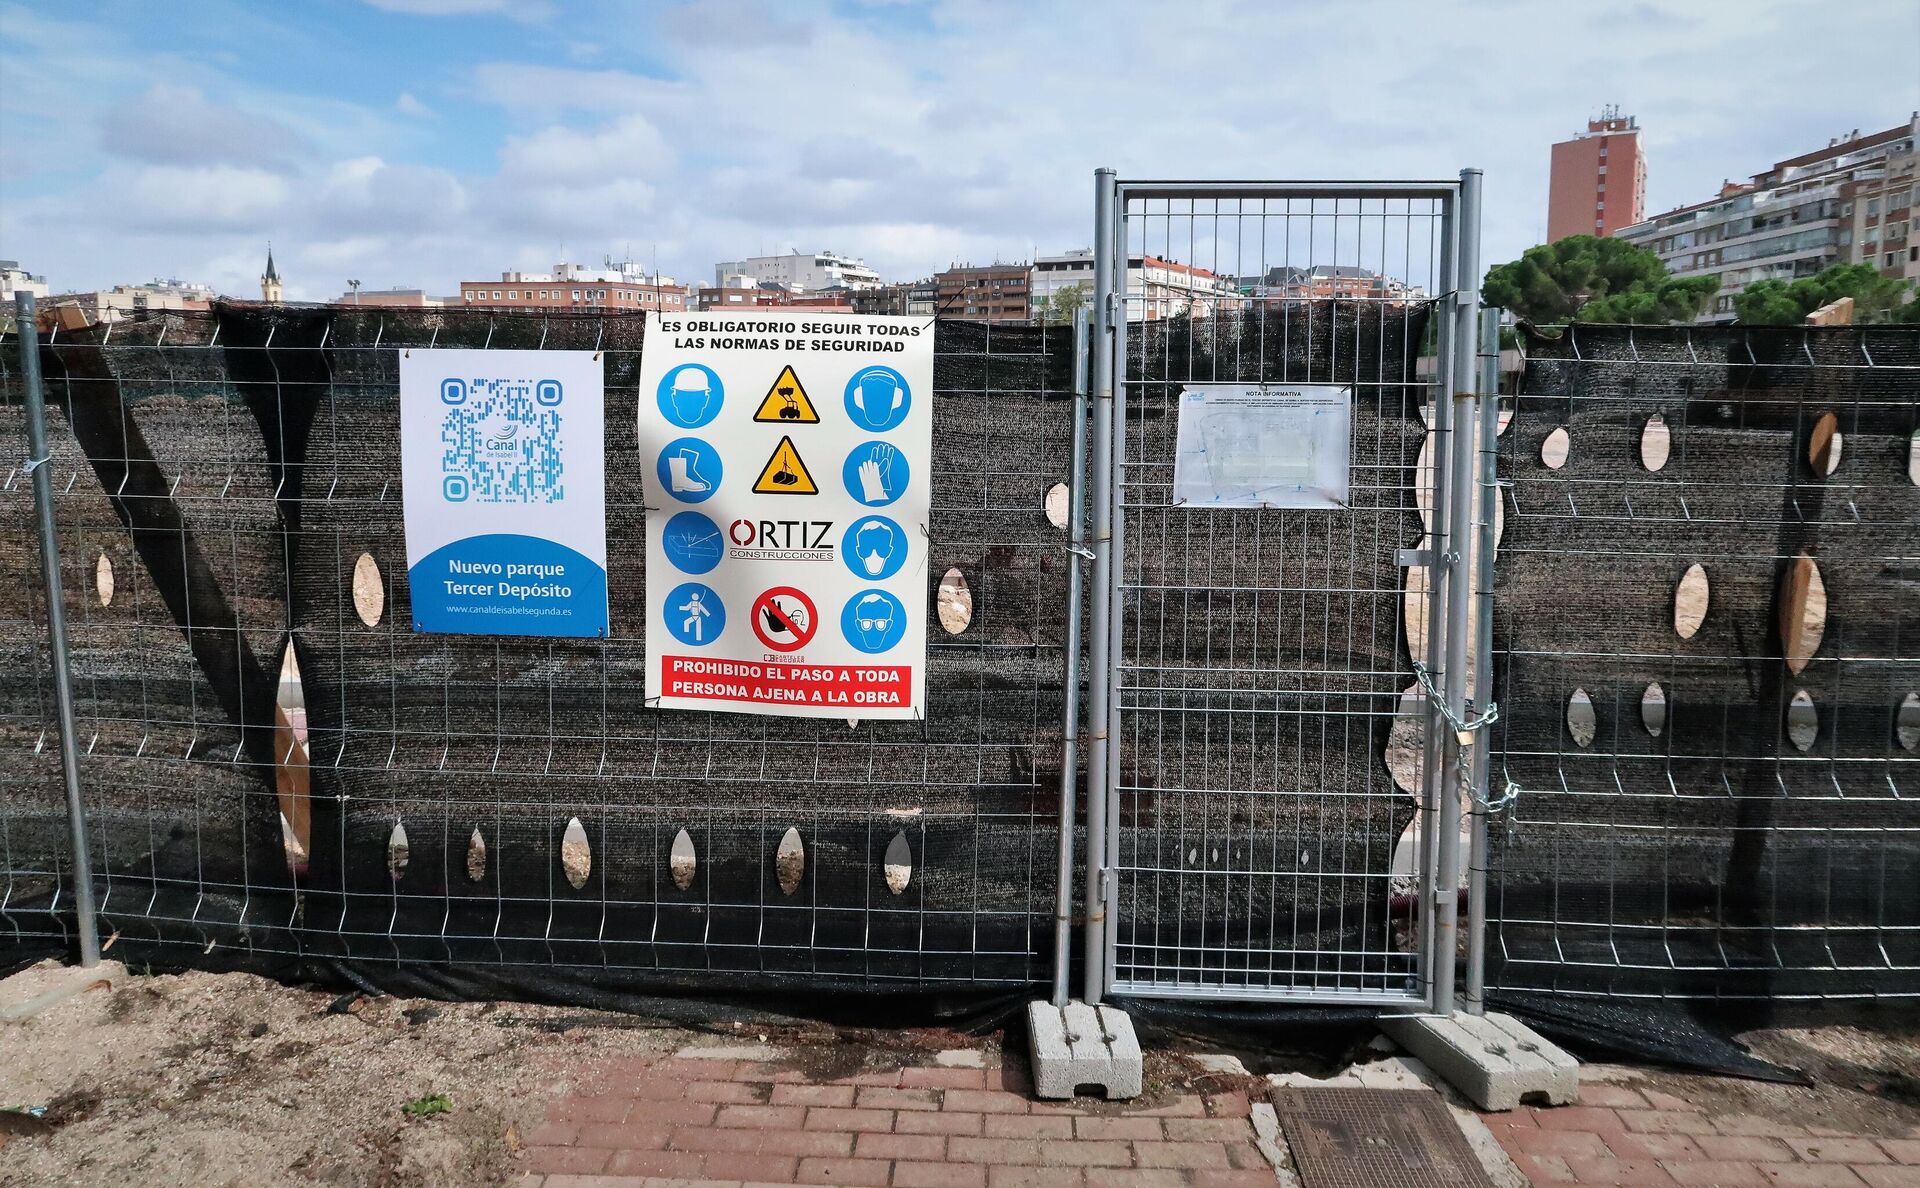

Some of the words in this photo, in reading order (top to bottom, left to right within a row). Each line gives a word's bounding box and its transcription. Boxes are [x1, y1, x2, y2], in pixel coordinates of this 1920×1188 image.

[662, 322, 681, 332] ES
[686, 321, 796, 334] OBLIGATORIO
[801, 323, 862, 335] SEGUIR
[867, 325, 920, 337] TODAS
[674, 338, 705, 349] LAS
[710, 338, 779, 350] NORMAS
[785, 339, 806, 351] DE
[811, 340, 905, 353] SEGURIDAD
[486, 439, 518, 451] Canal
[729, 519, 834, 549] ORTIZ
[730, 550, 834, 560] CONSTRUCCIONES
[449, 559, 502, 575] Nuevo
[507, 563, 565, 579] parque
[443, 581, 493, 596] Tercer
[499, 583, 572, 601] Depósito
[446, 606, 572, 616] www.canaldeisabelsegunda.es
[673, 660, 761, 678] PROHIBIDO
[766, 667, 786, 680] EL
[791, 669, 834, 682] PASO
[838, 670, 850, 682] A
[856, 670, 900, 683] TODA
[672, 681, 748, 698] PERSONA
[753, 687, 805, 701] AJENA
[811, 689, 823, 702] A
[827, 690, 849, 703] LA
[853, 691, 900, 703] OBRA
